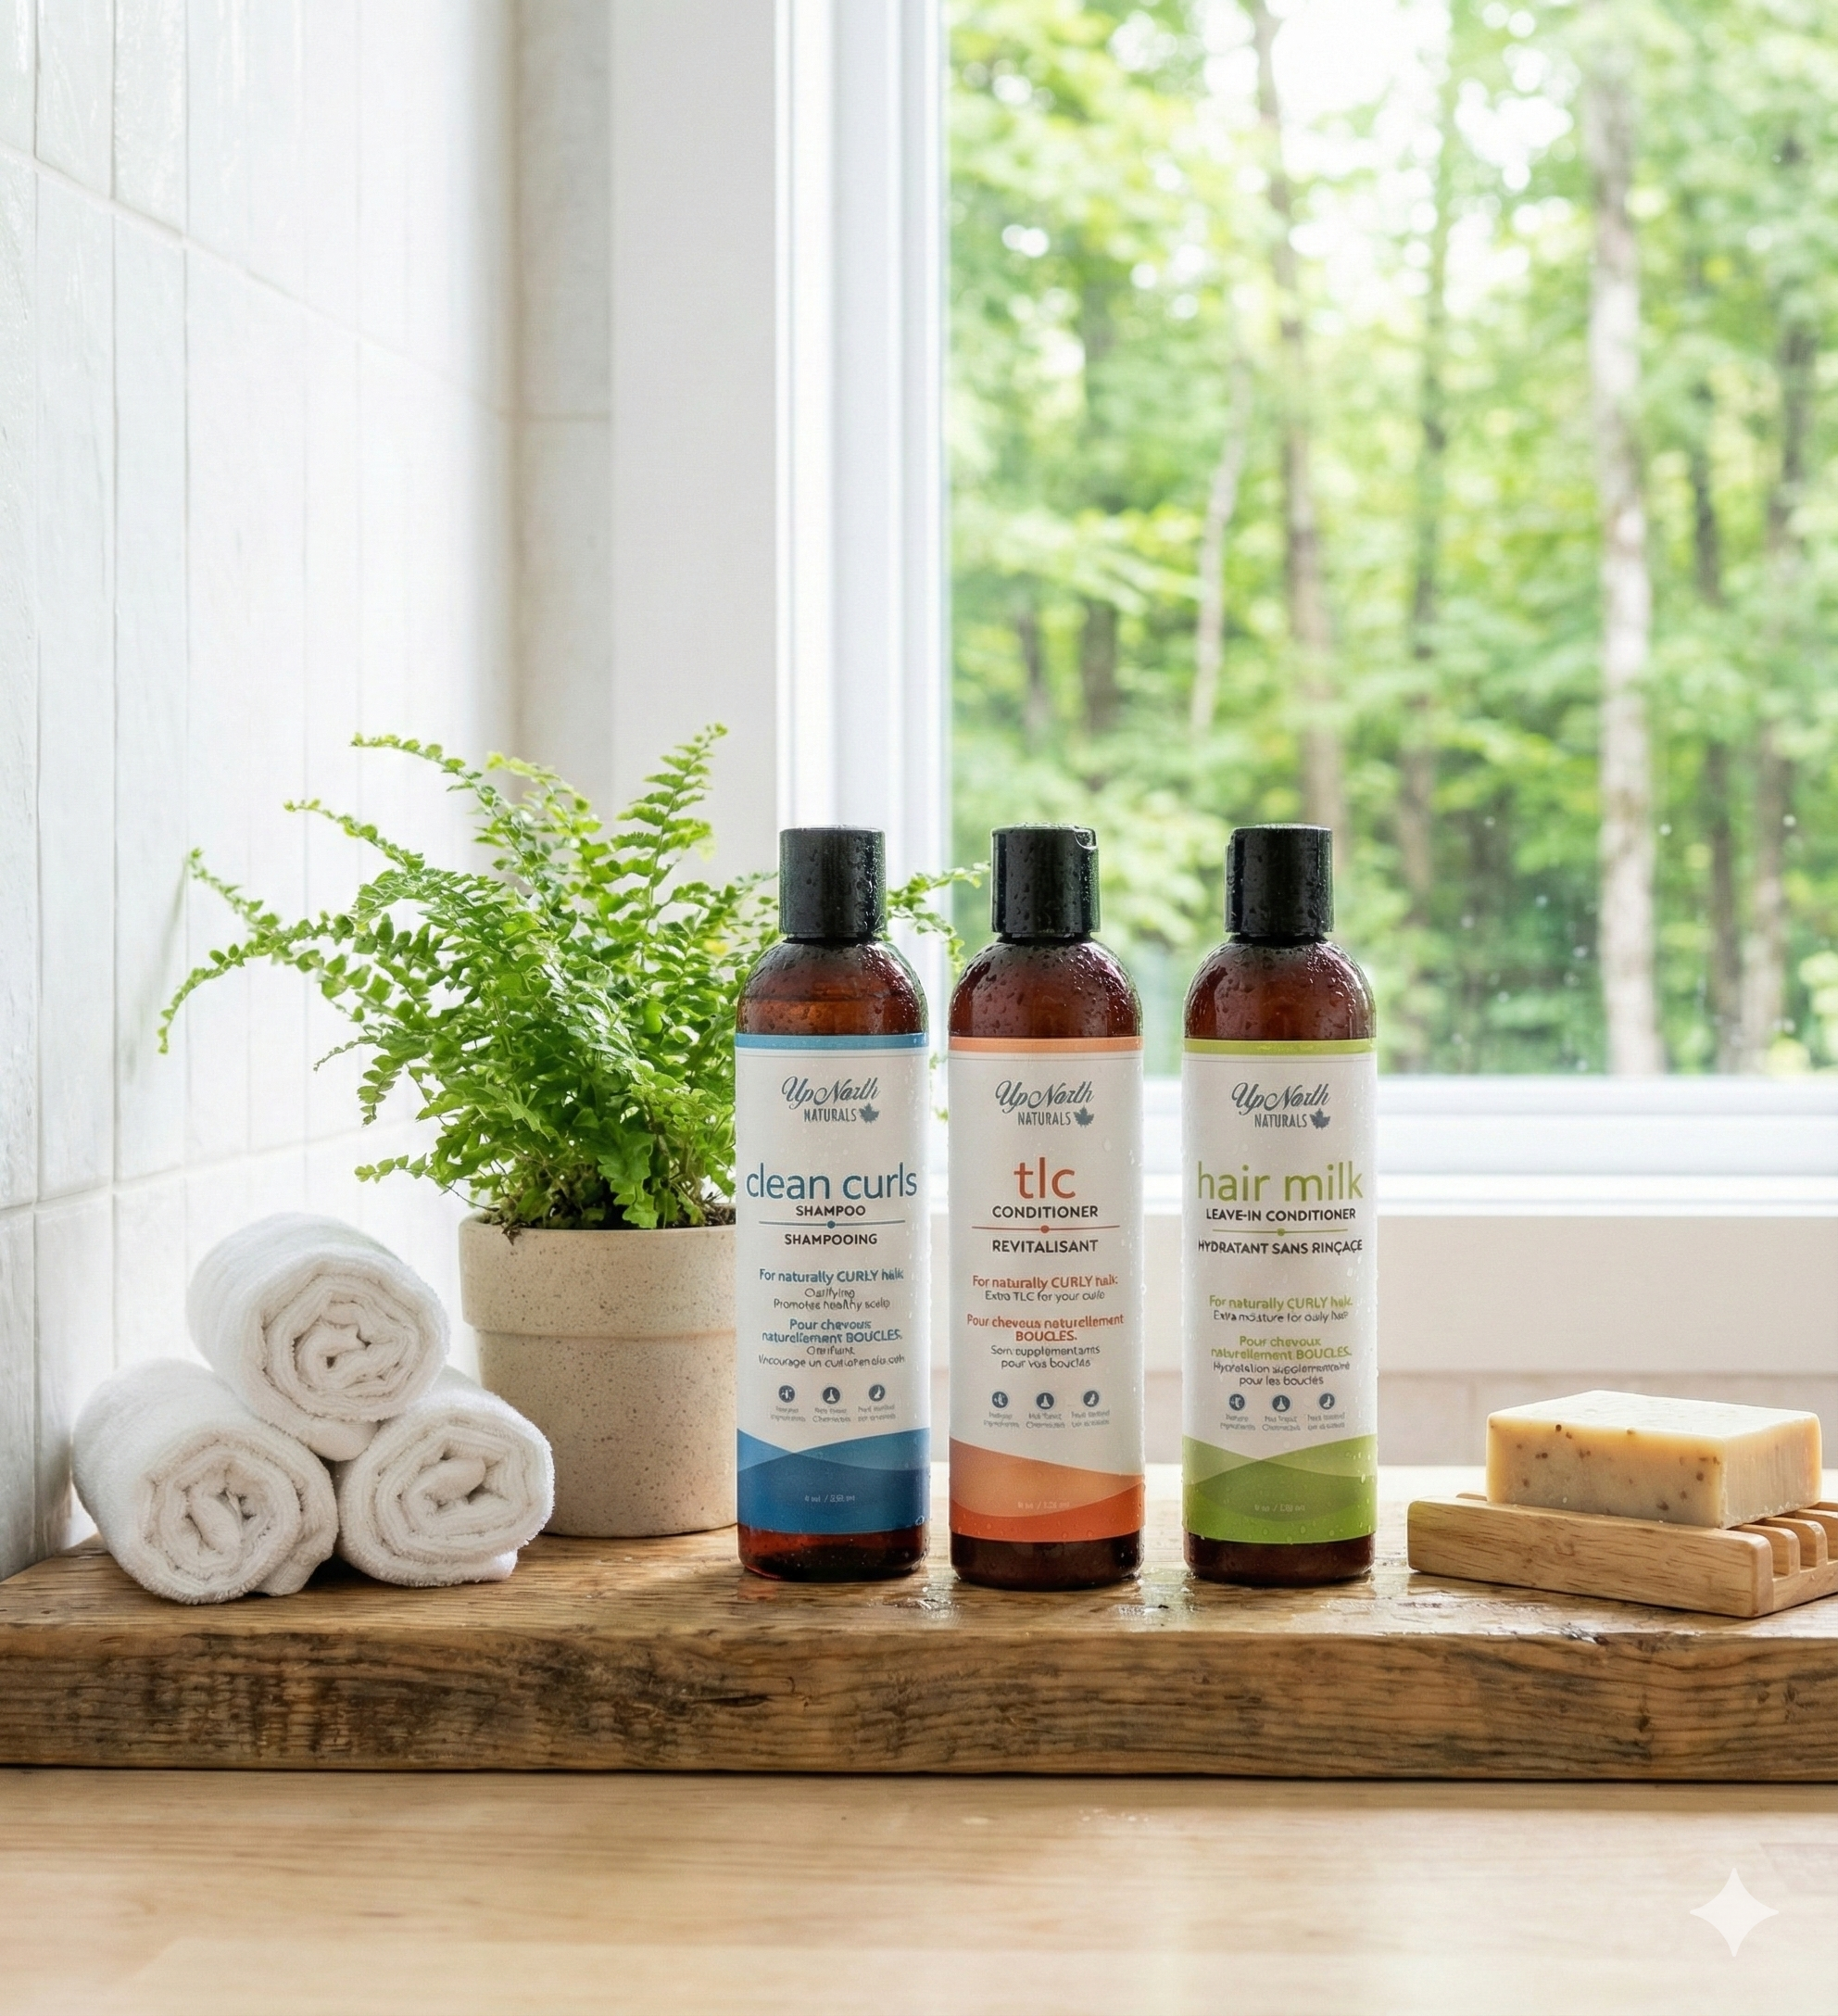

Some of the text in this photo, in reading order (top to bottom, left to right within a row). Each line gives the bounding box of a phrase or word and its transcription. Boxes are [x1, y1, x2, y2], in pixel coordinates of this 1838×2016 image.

[804, 1108, 856, 1122] NATURALS
[1018, 1112, 1071, 1126] NATURALS
[1254, 1114, 1307, 1128] NATURALS
[747, 1162, 917, 1200] clean curls
[1013, 1157, 1076, 1199] tlc
[1198, 1161, 1363, 1202] hair milk
[796, 1205, 865, 1216] SHAMPOO
[992, 1205, 1098, 1218] CONDITIONER
[1206, 1208, 1355, 1222] LEAVE-IN CONDITIONER
[785, 1233, 877, 1245] SHAMPOOING
[993, 1240, 1098, 1253] REVITALISANT
[1199, 1240, 1269, 1254] HYDRATANT
[1272, 1243, 1308, 1254] SANS
[760, 1268, 775, 1280] For
[778, 1270, 834, 1286] naturally
[837, 1270, 878, 1282] CURLY
[973, 1275, 989, 1288] For
[992, 1277, 1048, 1290] naturally
[1051, 1276, 1093, 1289] CURLY
[1013, 1292, 1034, 1301] TLC
[1038, 1292, 1052, 1301] for
[1055, 1293, 1079, 1304] your
[1209, 1295, 1227, 1307] For
[1228, 1297, 1284, 1312] naturally
[1287, 1297, 1328, 1310] CURLY
[790, 1319, 817, 1329] Pour
[967, 1314, 989, 1327] Pour
[1240, 1336, 1266, 1346] Pour
[1001, 1360, 1026, 1368] pour
